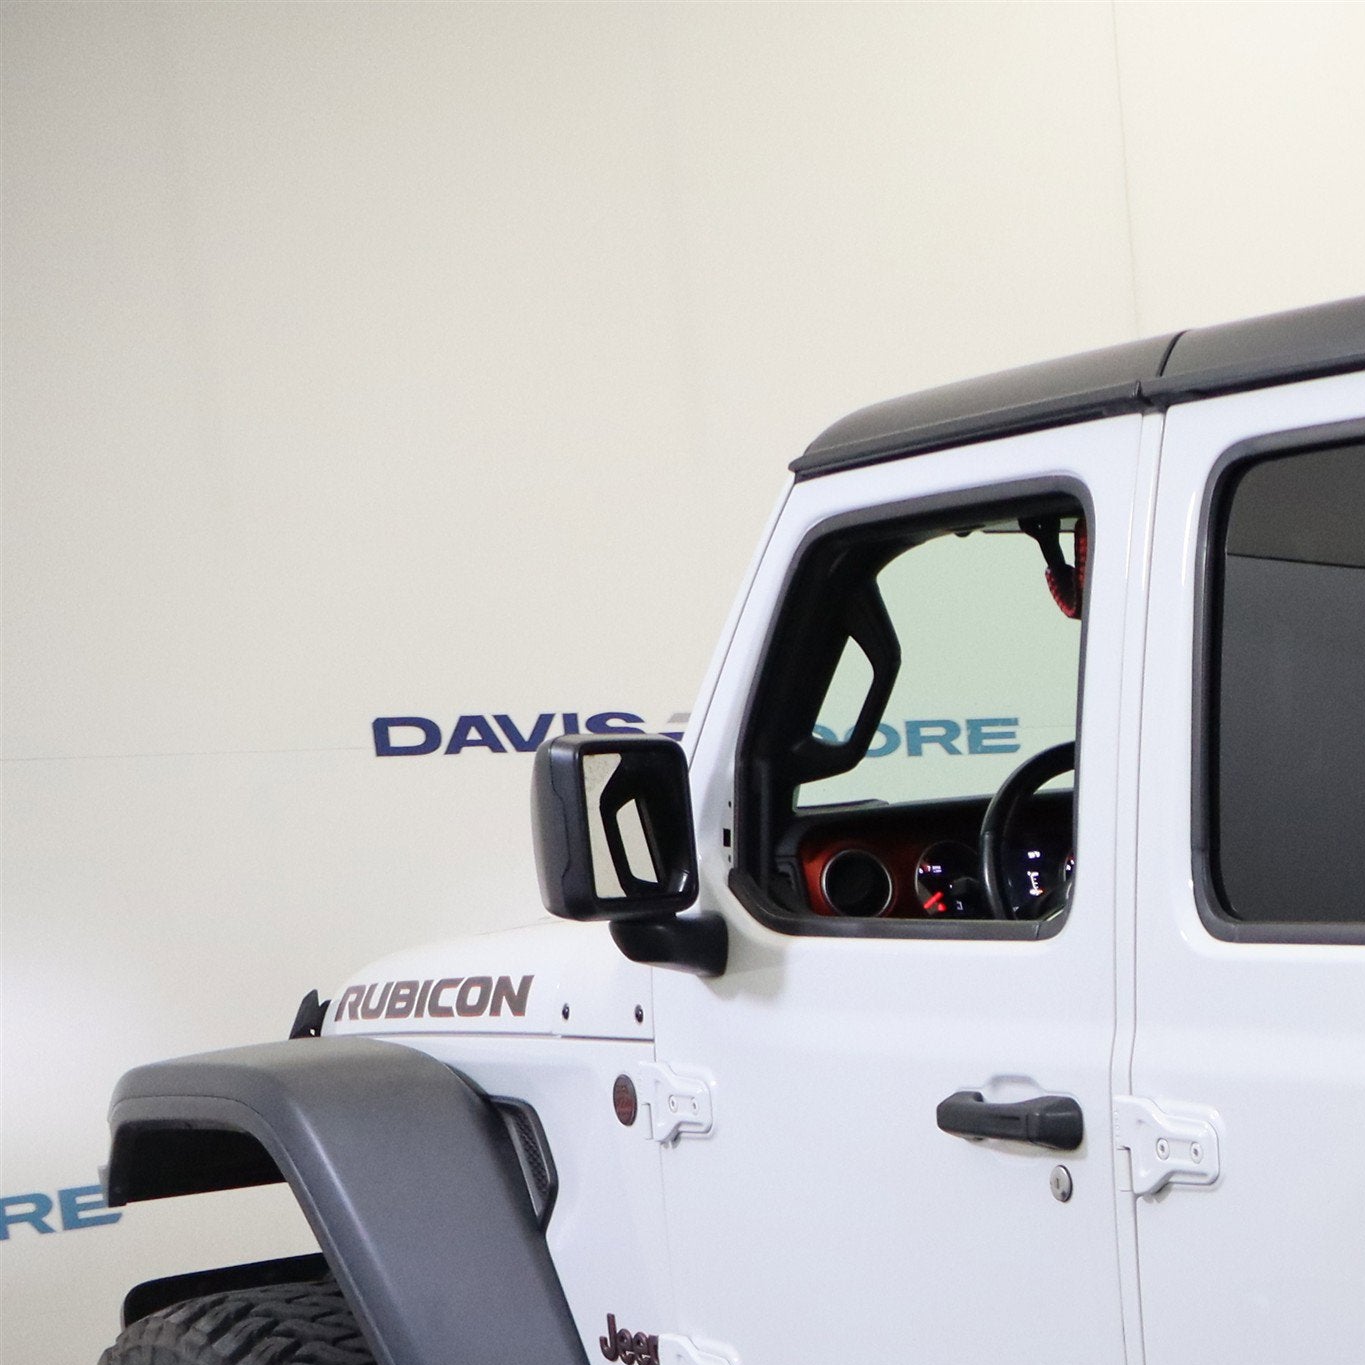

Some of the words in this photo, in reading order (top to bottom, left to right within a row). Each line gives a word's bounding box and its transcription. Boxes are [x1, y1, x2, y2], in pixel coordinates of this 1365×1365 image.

[372, 711, 646, 757] DAVIS
[334, 974, 535, 1022] RUBICON
[0, 1184, 123, 1240] RE
